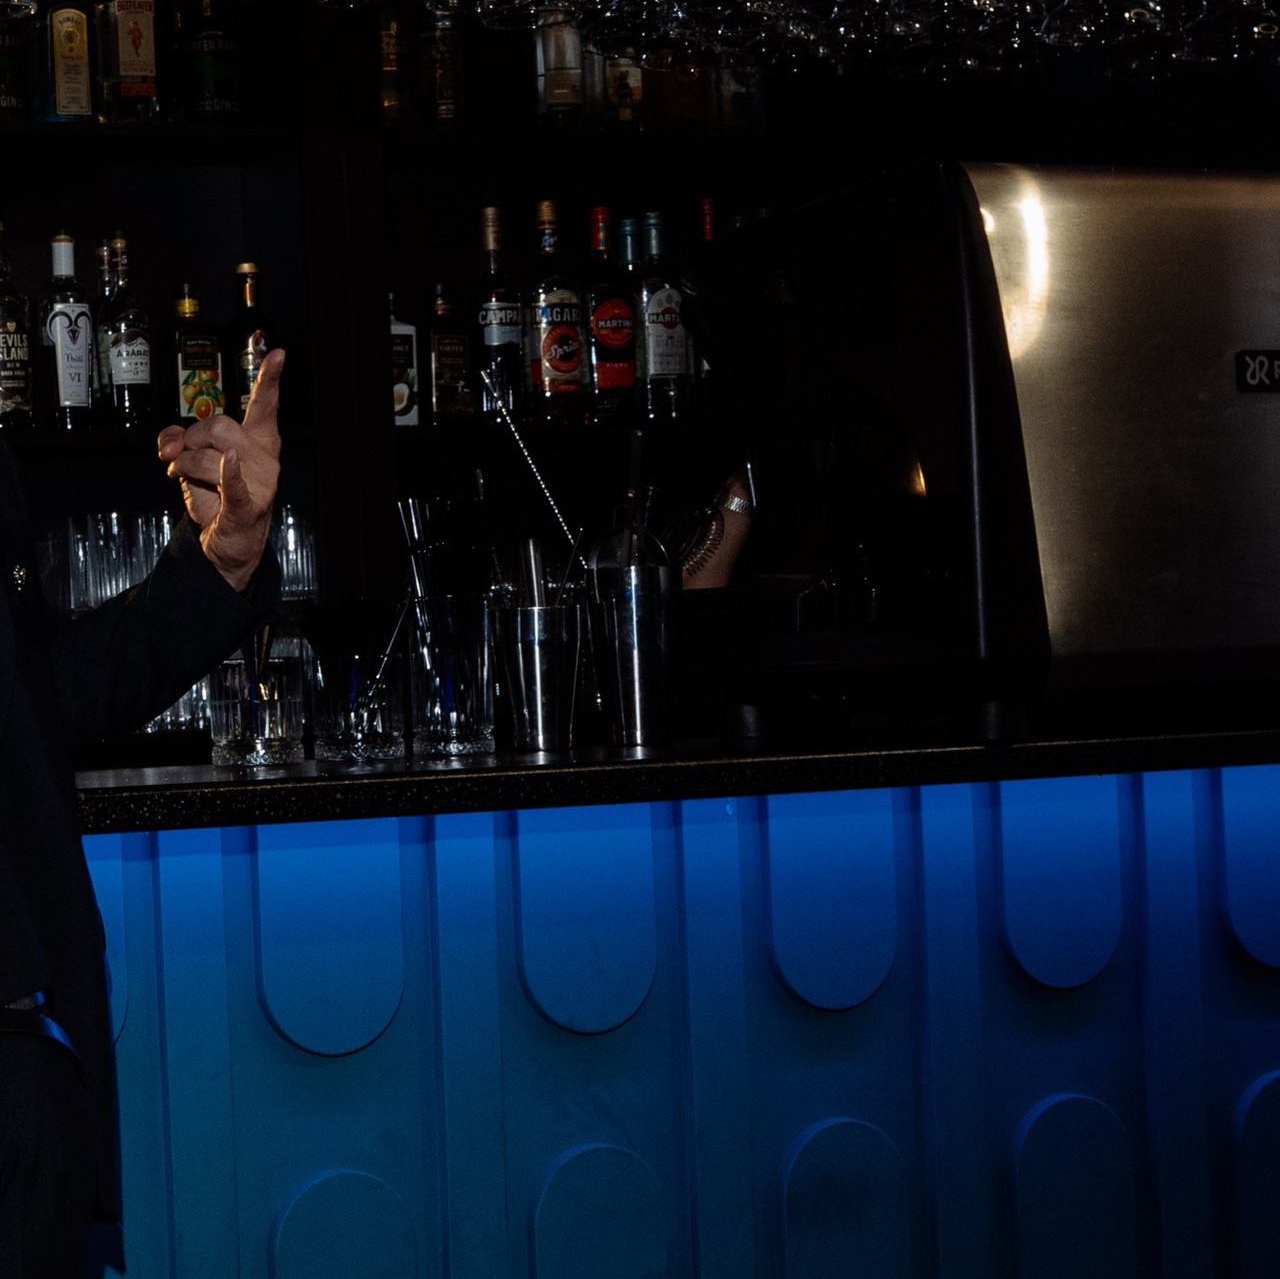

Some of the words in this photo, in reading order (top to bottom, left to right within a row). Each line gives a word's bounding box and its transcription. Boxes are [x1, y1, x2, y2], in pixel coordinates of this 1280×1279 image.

[0, 95, 16, 107] GIN
[213, 100, 232, 111] GIN
[479, 310, 519, 324] CAMPA
[650, 313, 680, 323] MARTI
[68, 372, 81, 382] VI
